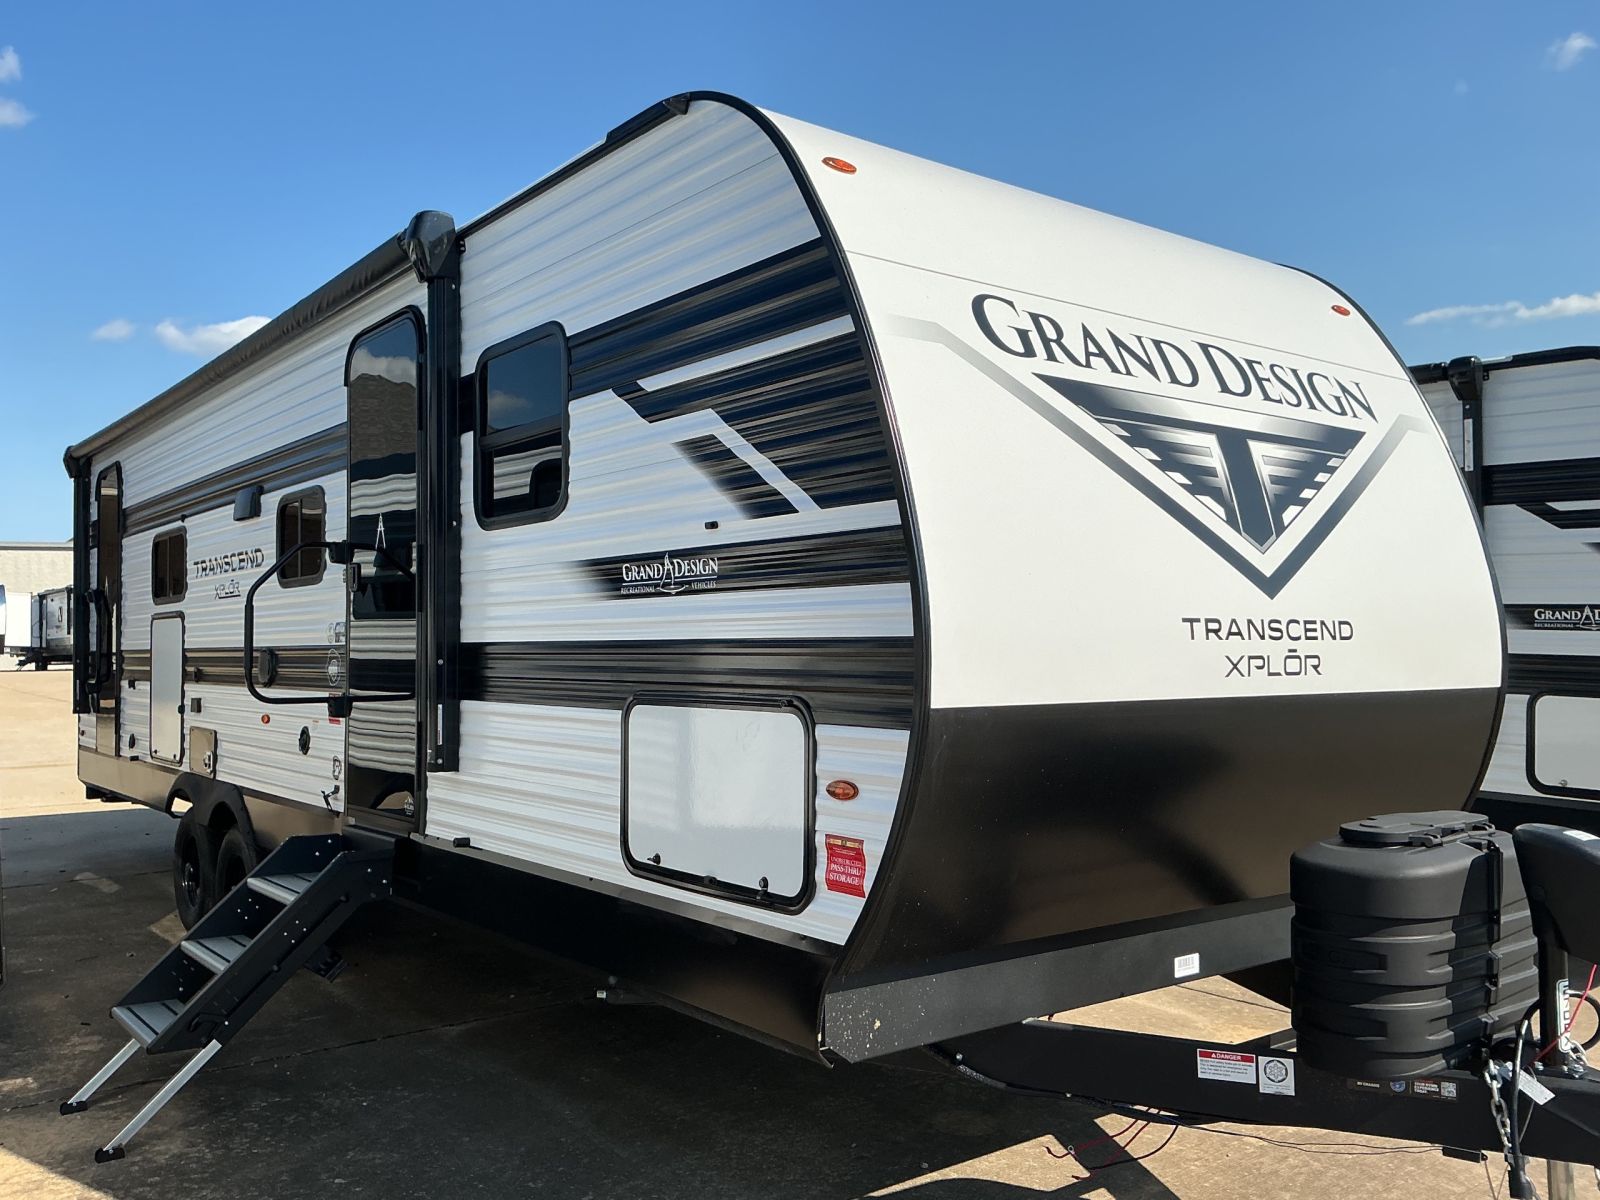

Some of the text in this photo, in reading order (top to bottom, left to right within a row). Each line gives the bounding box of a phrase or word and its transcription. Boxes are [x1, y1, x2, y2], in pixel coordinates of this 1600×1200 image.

[971, 294, 1378, 423] GRAND DESIGN
[194, 548, 264, 578] TRANSCEND
[622, 557, 718, 581] GRAND DESIGN
[620, 581, 716, 594] RECREATIONAL VEHICLES
[1534, 608, 1581, 620] GRAND
[1181, 617, 1354, 641] TRANSCEND
[830, 873, 859, 885] STORAGE
